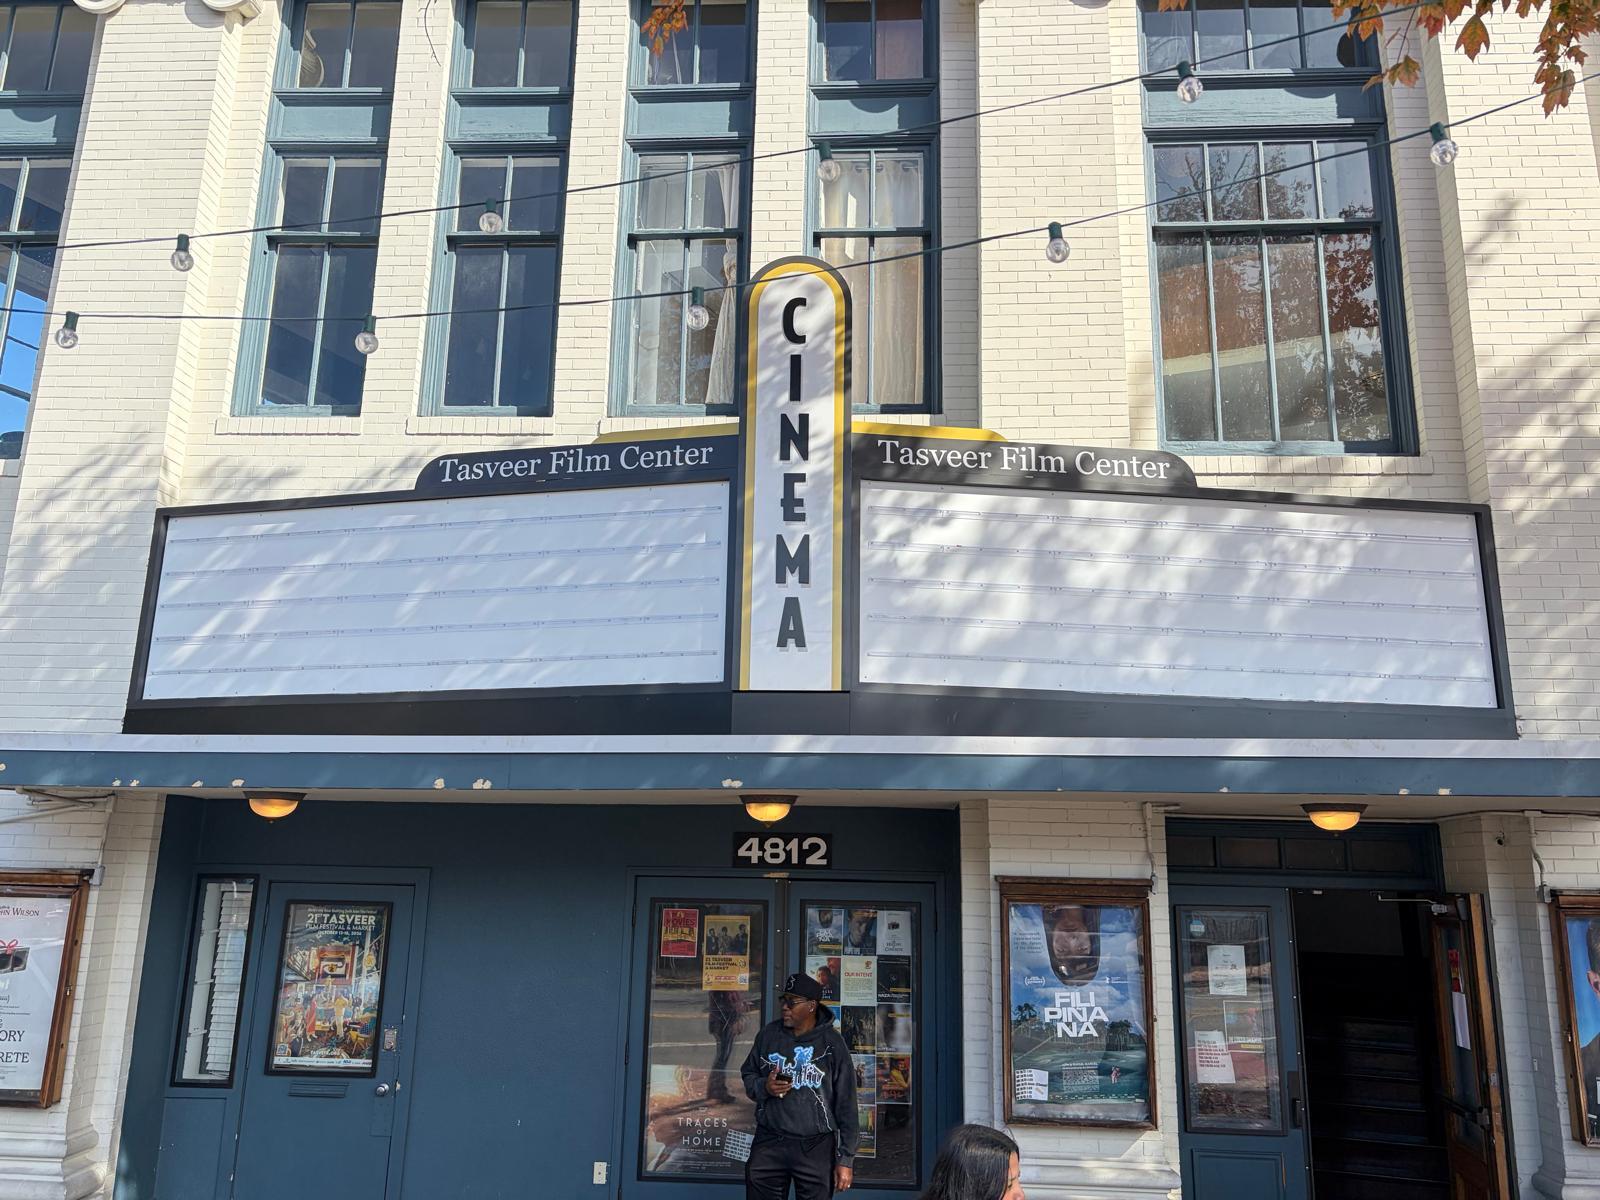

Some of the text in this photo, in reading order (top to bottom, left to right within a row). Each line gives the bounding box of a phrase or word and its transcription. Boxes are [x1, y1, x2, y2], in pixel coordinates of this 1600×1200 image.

[439, 444, 713, 483] Tasveer Film Center
[877, 439, 1170, 479] Tasveer Film Center
[775, 297, 811, 650] CINEMA
[737, 836, 828, 865] 4812
[323, 914, 376, 925] TASVEER
[1055, 991, 1095, 1007] FILI
[1057, 1022, 1099, 1037] NA
[677, 1117, 728, 1128] TRACES
[682, 1136, 721, 1146] HOME
